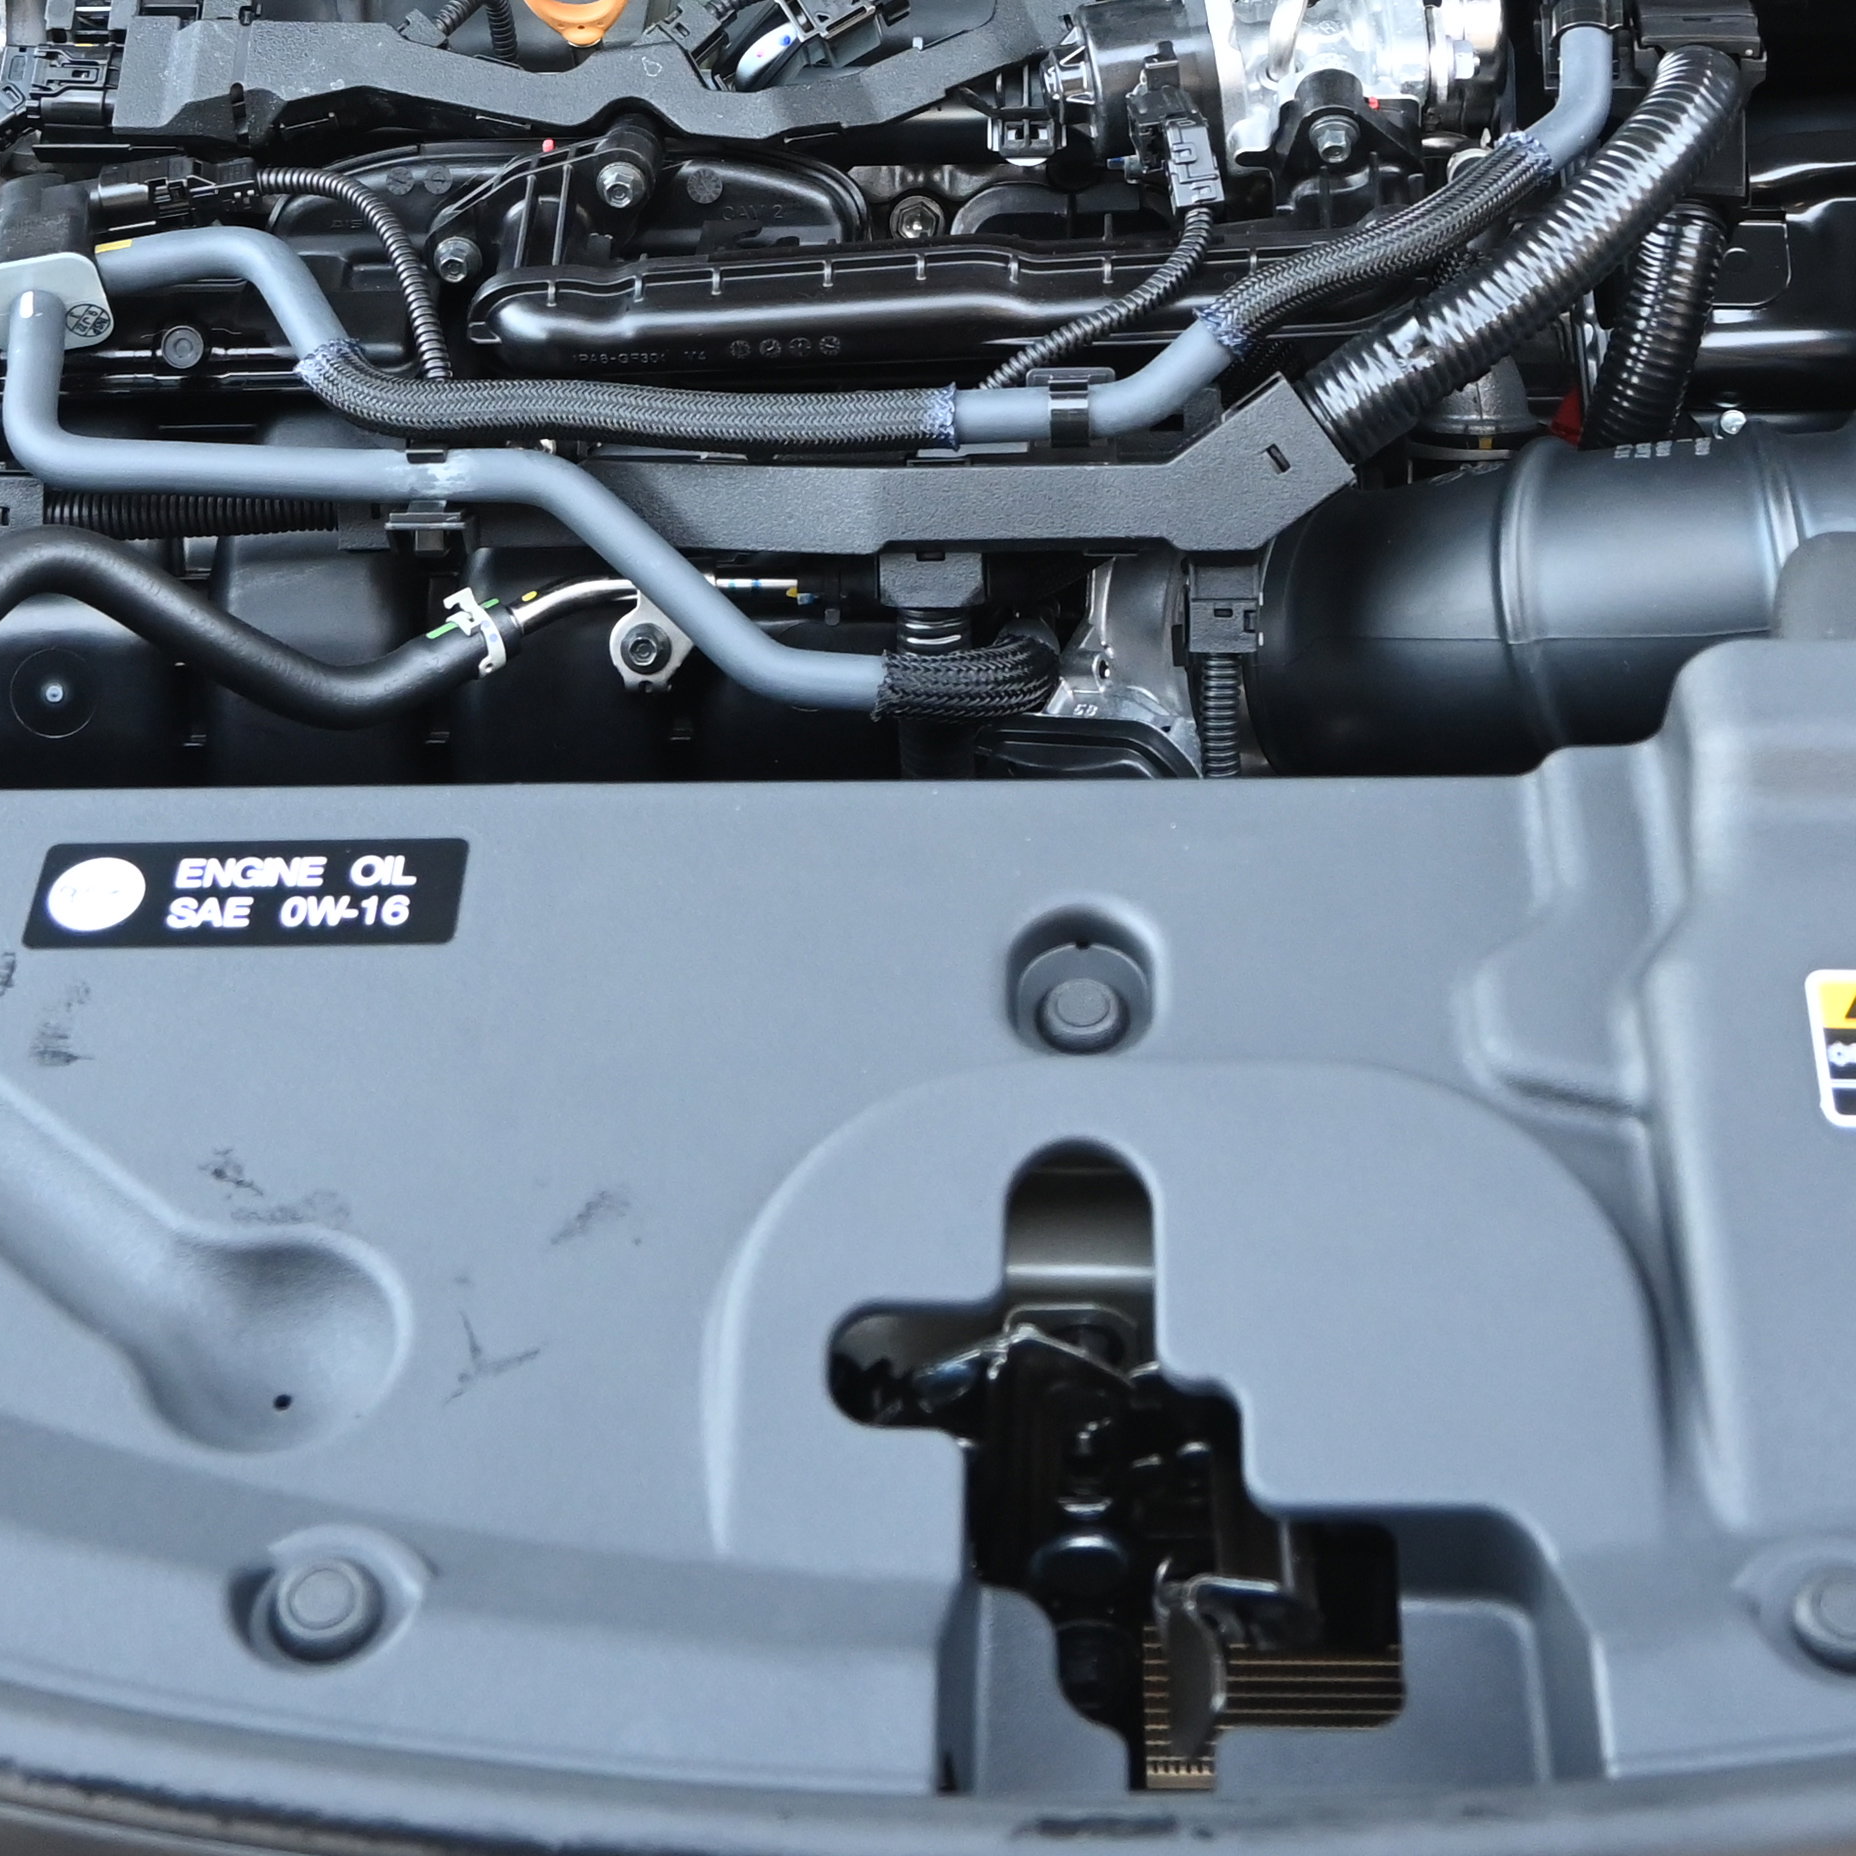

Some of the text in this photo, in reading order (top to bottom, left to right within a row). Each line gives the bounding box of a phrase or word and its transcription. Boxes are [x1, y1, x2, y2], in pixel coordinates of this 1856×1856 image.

[174, 855, 417, 888] ENGINE OIL
[166, 895, 411, 928] SAE 0W-16
